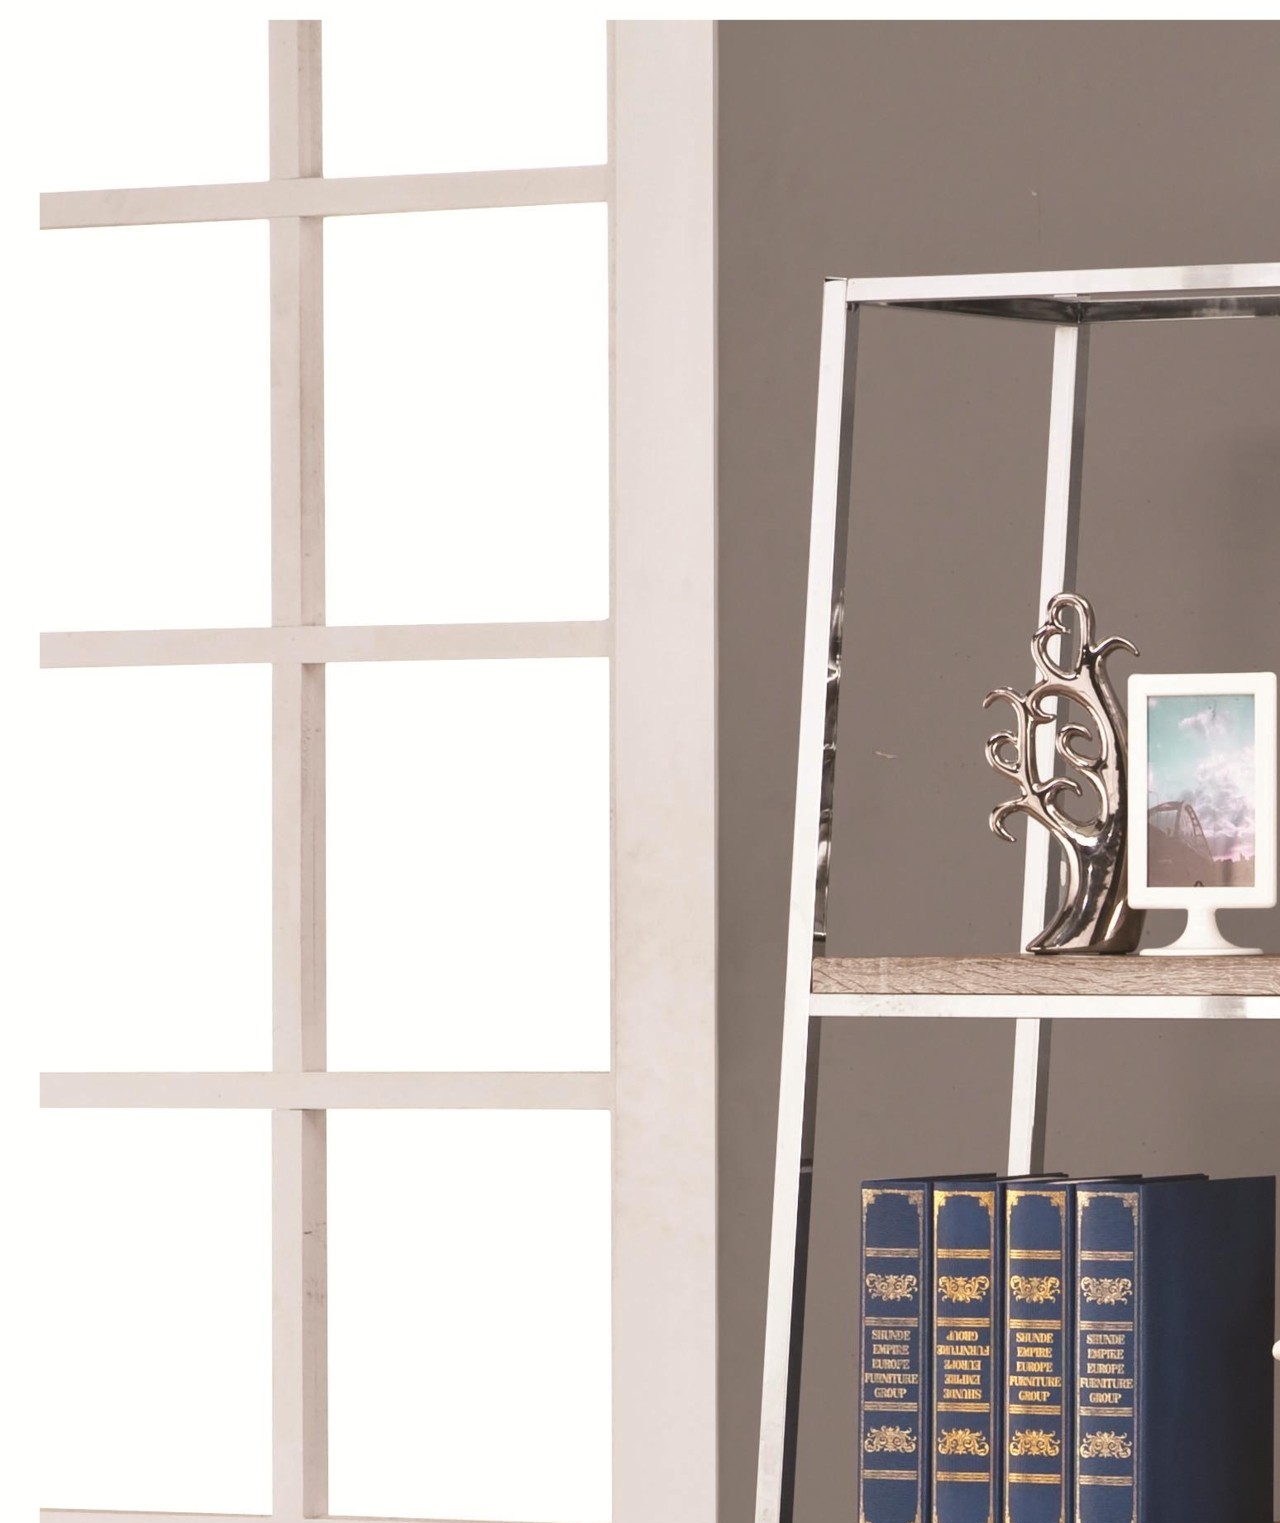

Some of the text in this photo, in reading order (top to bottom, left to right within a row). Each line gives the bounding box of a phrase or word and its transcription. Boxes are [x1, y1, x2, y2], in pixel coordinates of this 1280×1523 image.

[871, 1329, 911, 1341] SHUNDE
[1015, 1332, 1054, 1344] SHUNDE
[1086, 1333, 1125, 1345] SHUNDE
[872, 1344, 910, 1355] EMPIRE
[1016, 1346, 1053, 1358] EMPIRE
[1087, 1348, 1125, 1360] EMPIRE
[871, 1358, 910, 1370] EUROPE
[1016, 1361, 1053, 1373] EUROPE
[1086, 1363, 1125, 1374] EUROPE
[864, 1372, 918, 1385] FURNITURE
[1009, 1375, 1062, 1387] FURNITURE
[1080, 1377, 1133, 1389] FURNITURE
[874, 1387, 907, 1399] GROUP
[1018, 1390, 1051, 1402] GROUP
[1089, 1392, 1122, 1404] GROUP
